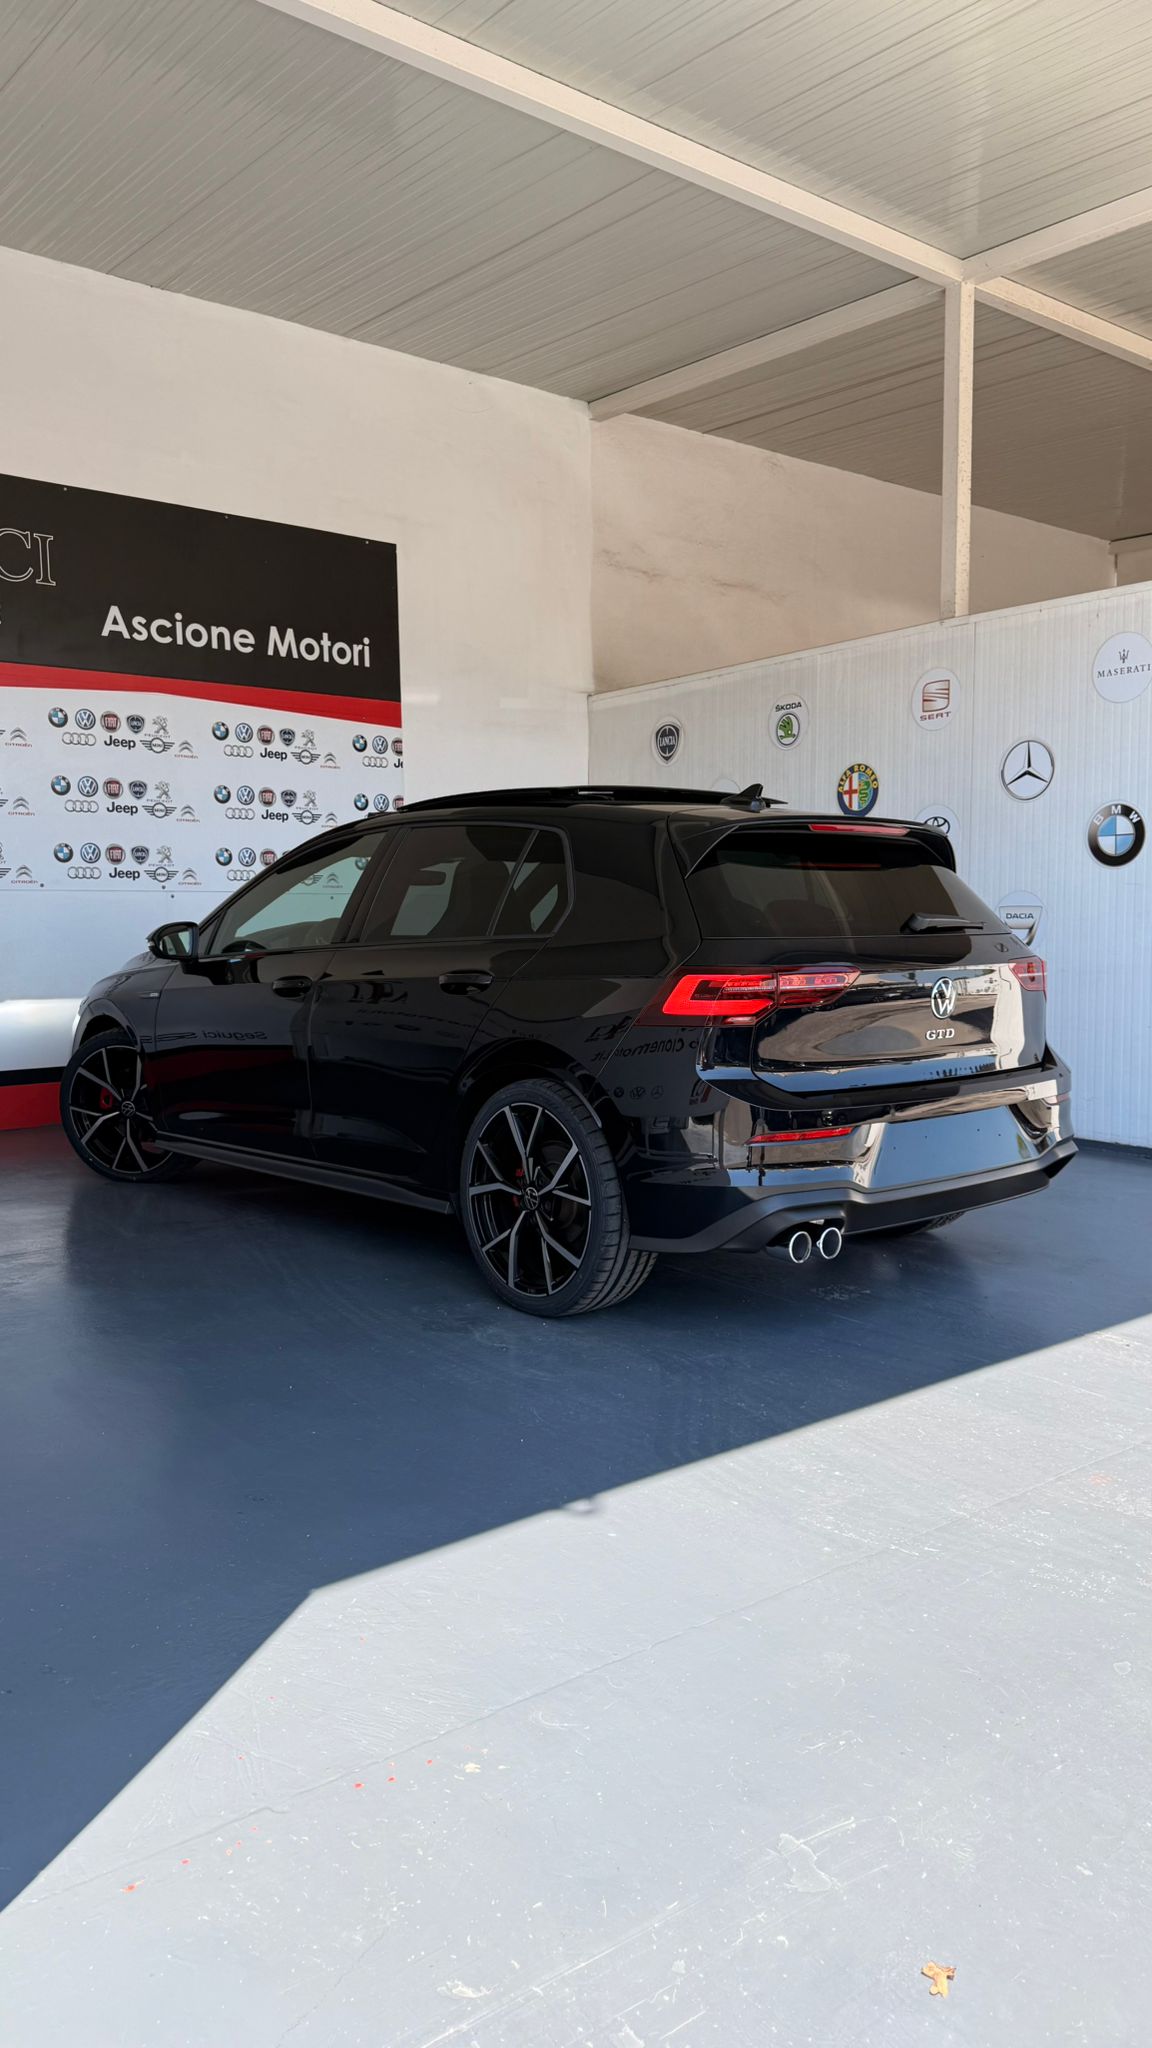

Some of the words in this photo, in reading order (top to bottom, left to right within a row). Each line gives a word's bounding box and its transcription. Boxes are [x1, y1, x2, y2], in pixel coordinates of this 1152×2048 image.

[101, 605, 256, 654] Ascione
[267, 625, 371, 668] Motori
[1097, 663, 1151, 679] MASERATI
[920, 711, 952, 721] SEAT
[104, 735, 136, 750] Jeep
[260, 747, 287, 762] Jeep
[854, 764, 878, 789] ROMEO
[106, 801, 138, 816] Jeep
[261, 808, 289, 823] Jeep
[1093, 804, 1141, 826] BMW
[109, 867, 140, 881] Jeep
[926, 1028, 955, 1041] GTD
